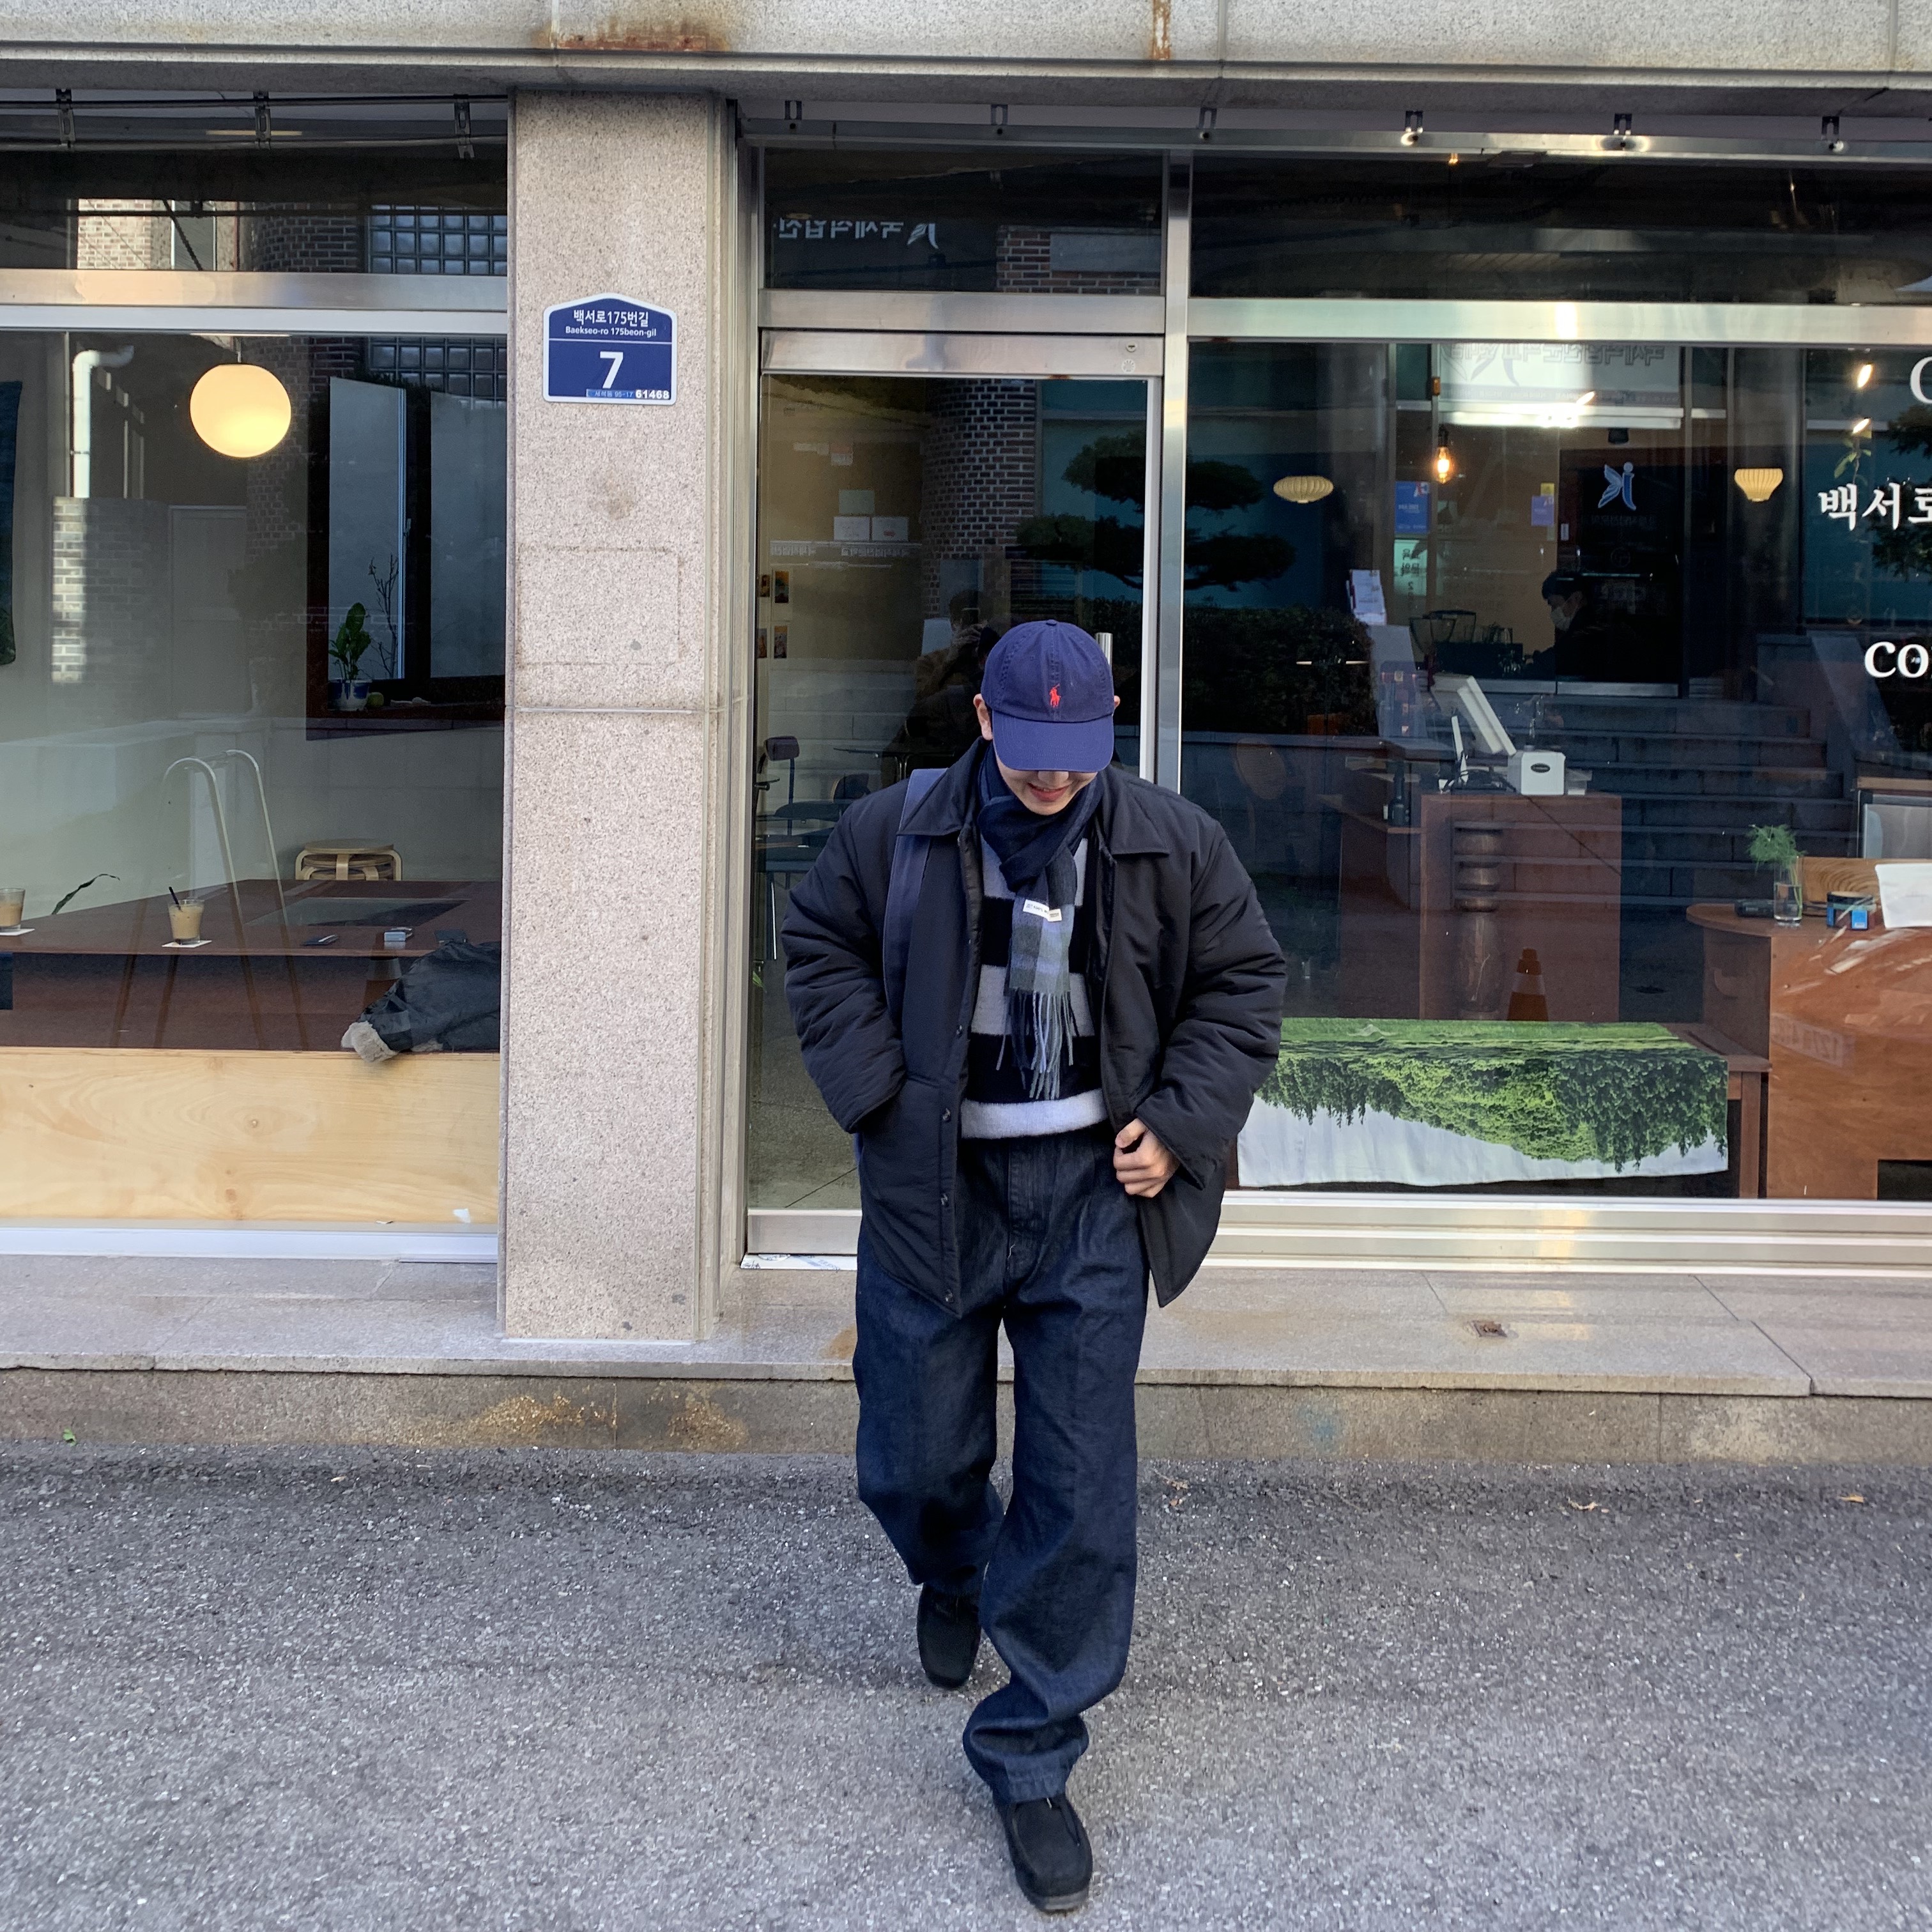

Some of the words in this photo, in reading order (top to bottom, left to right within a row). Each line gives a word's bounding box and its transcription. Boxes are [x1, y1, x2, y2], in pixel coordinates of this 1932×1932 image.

[573, 309, 649, 328] 백서로175번길
[565, 326, 609, 335] Baekseo-ro
[611, 327, 657, 338] 175beon-gil
[599, 351, 624, 389] 7
[635, 389, 670, 399] 61468
